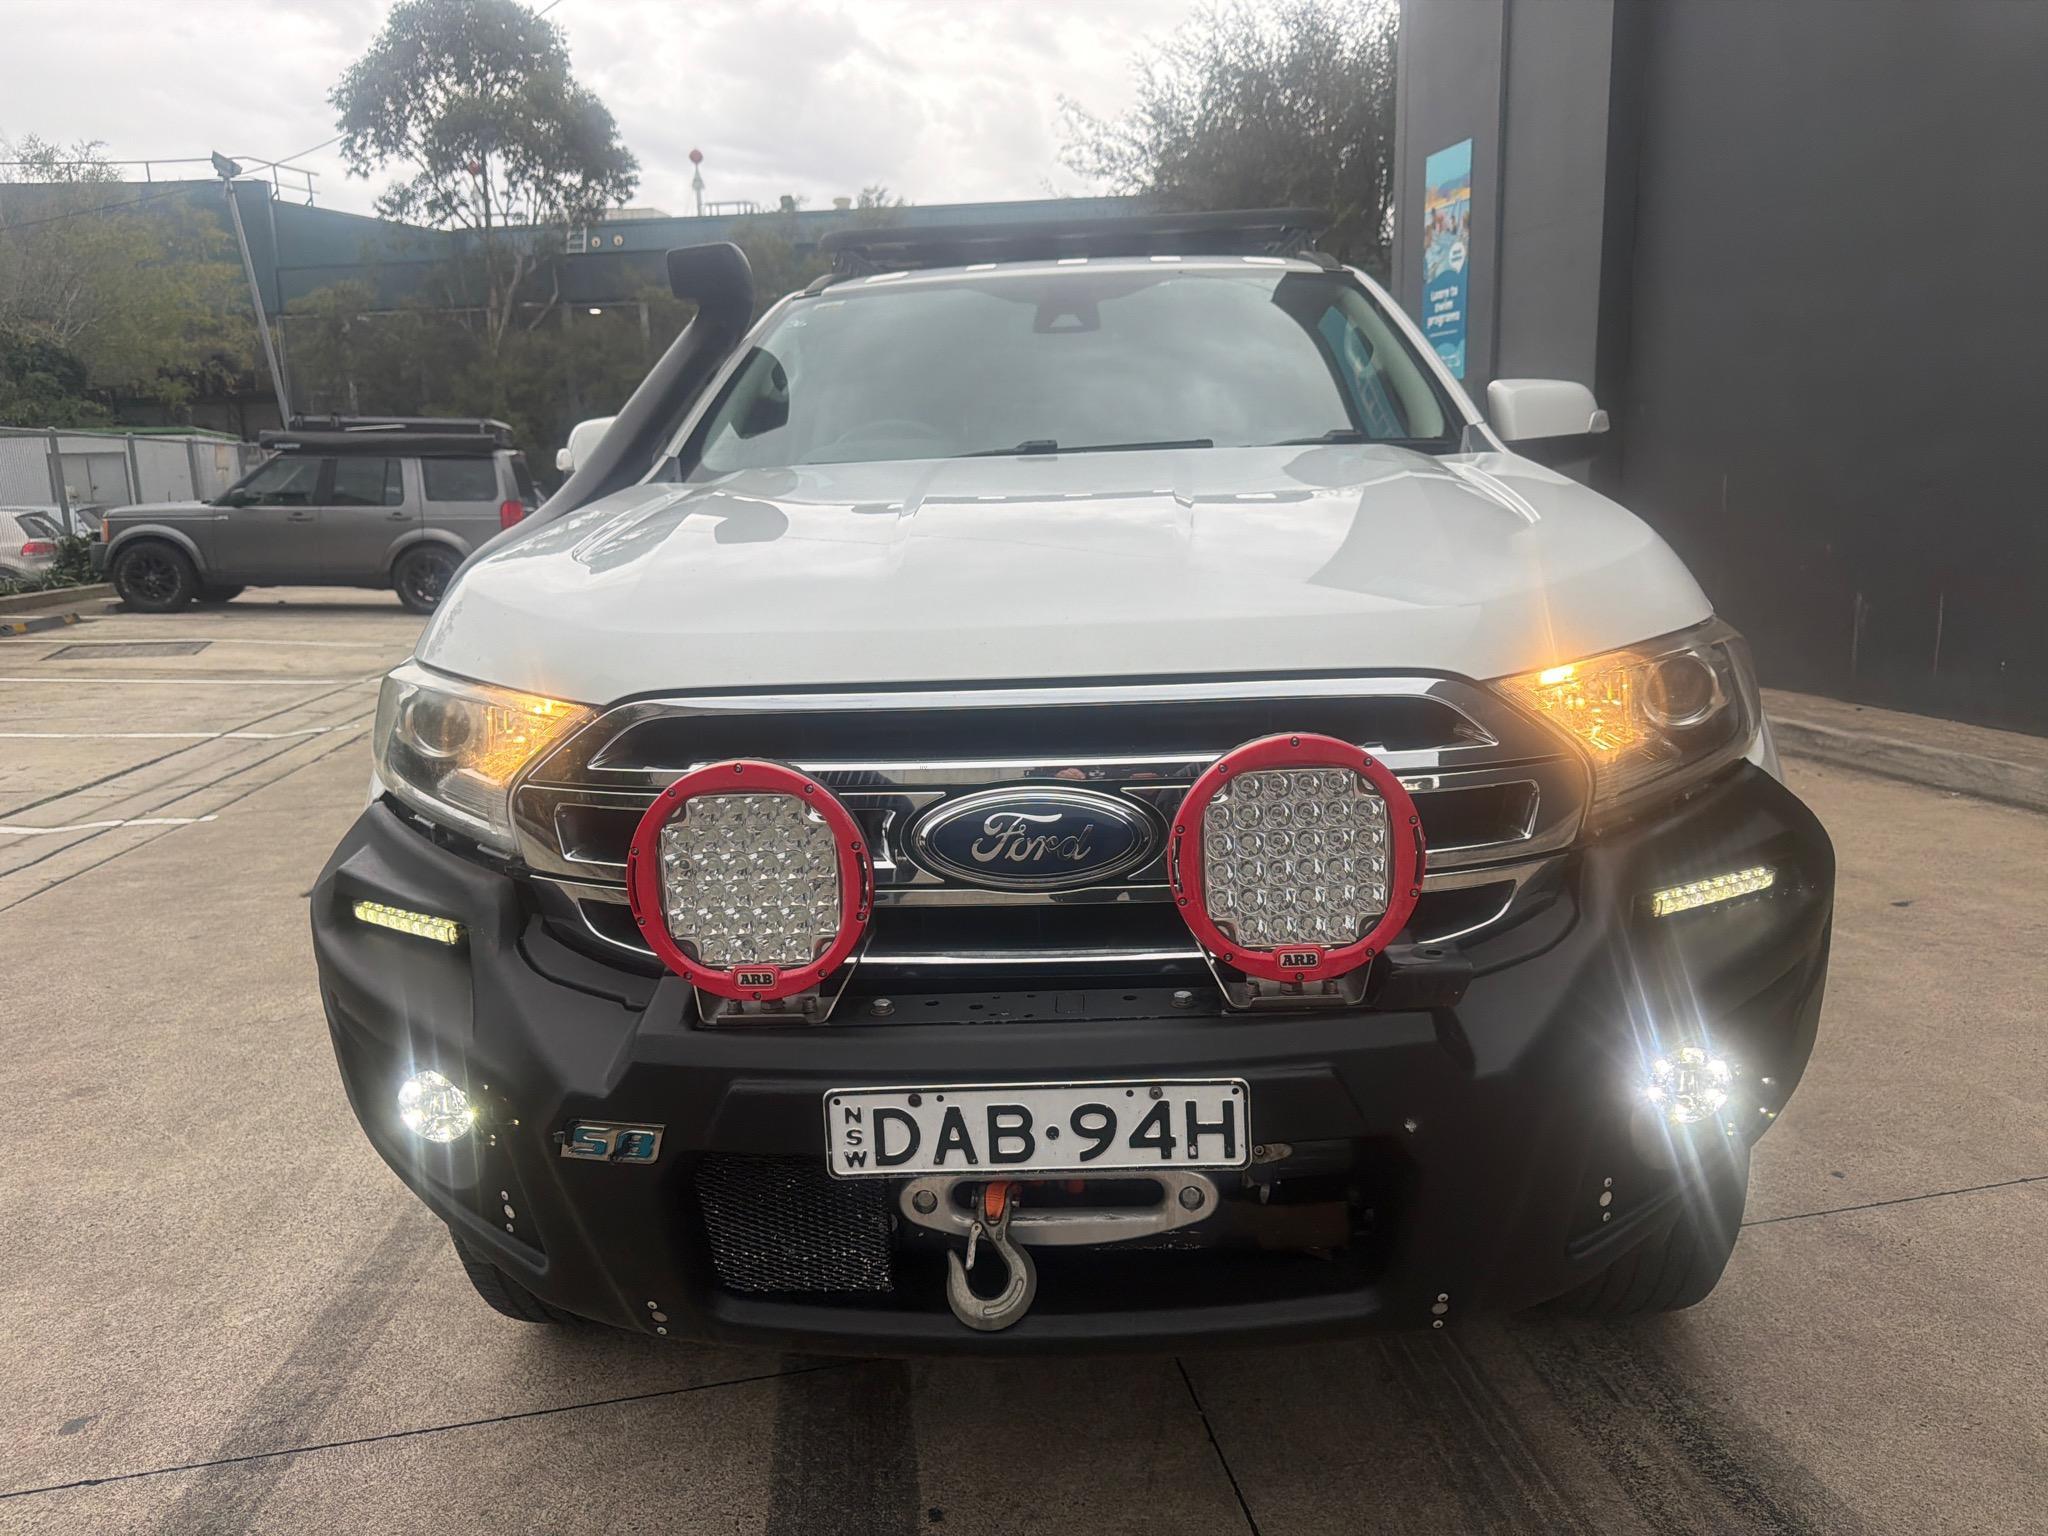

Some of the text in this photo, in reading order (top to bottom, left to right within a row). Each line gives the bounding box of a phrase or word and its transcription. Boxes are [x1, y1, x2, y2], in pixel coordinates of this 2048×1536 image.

[971, 812, 1094, 862] Ford
[1282, 954, 1317, 966] ARB
[740, 974, 773, 985] ARB
